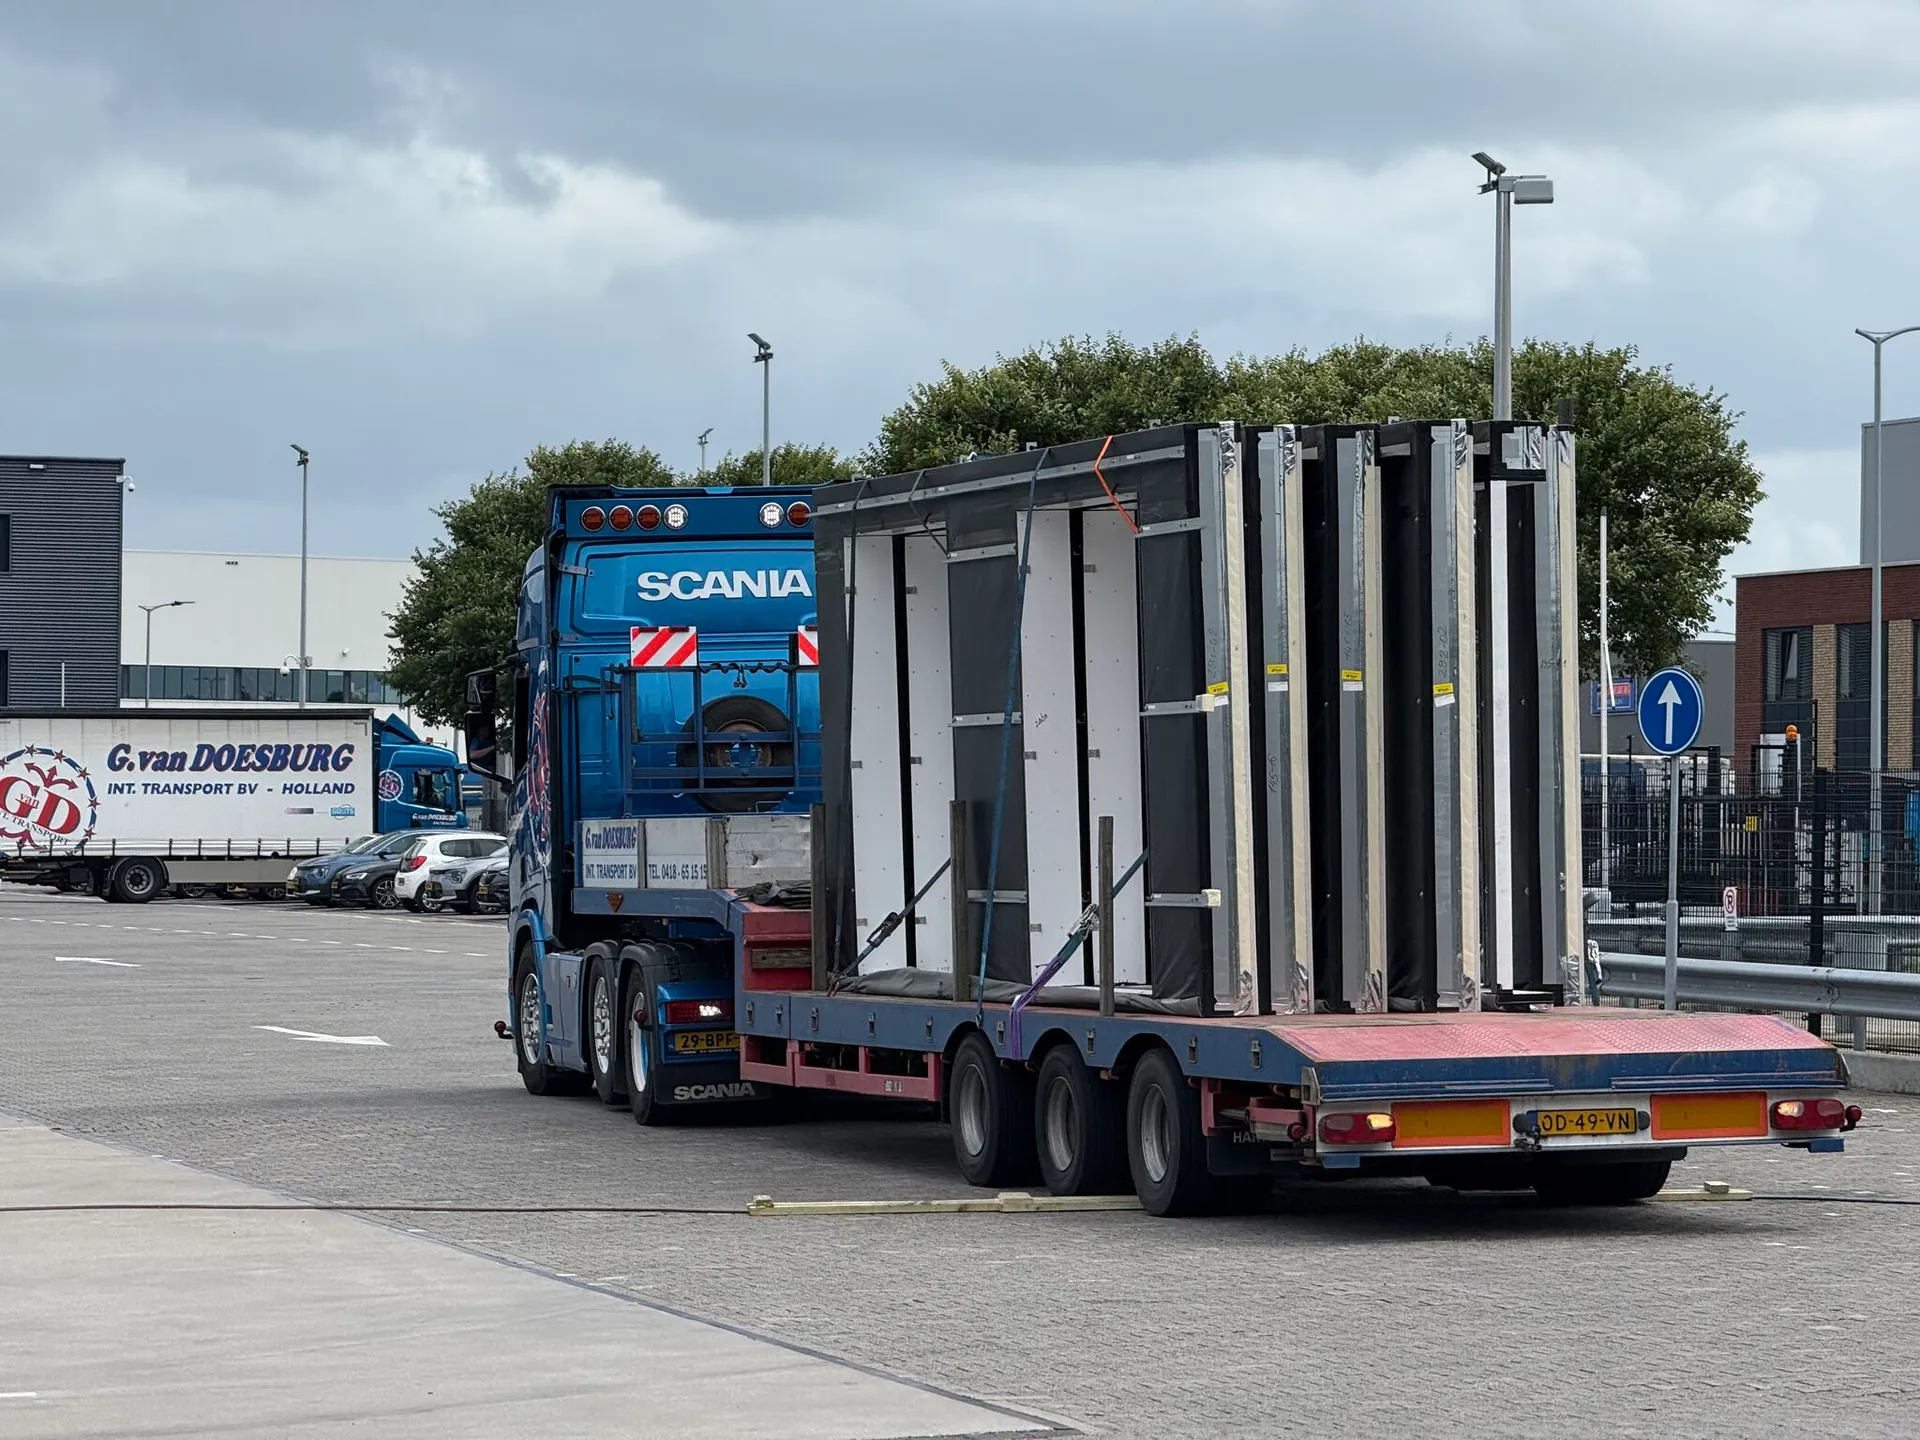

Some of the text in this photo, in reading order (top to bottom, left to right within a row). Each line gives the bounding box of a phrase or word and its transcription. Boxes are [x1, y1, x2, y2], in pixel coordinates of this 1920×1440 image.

[637, 569, 813, 601] SCANIA
[189, 743, 355, 772] DOESBURG
[107, 783, 136, 795] INT.
[141, 783, 234, 795] TRANSPORT
[237, 783, 259, 795] BV
[281, 783, 355, 795] HOLLAND
[602, 826, 636, 850] DOESBURG
[596, 864, 628, 879] TRANSPORT
[661, 864, 677, 879] 0418
[681, 864, 690, 879] 65
[691, 864, 699, 879] 15
[680, 1032, 739, 1049] 29-BPF-
[673, 1082, 756, 1100] SCANIA
